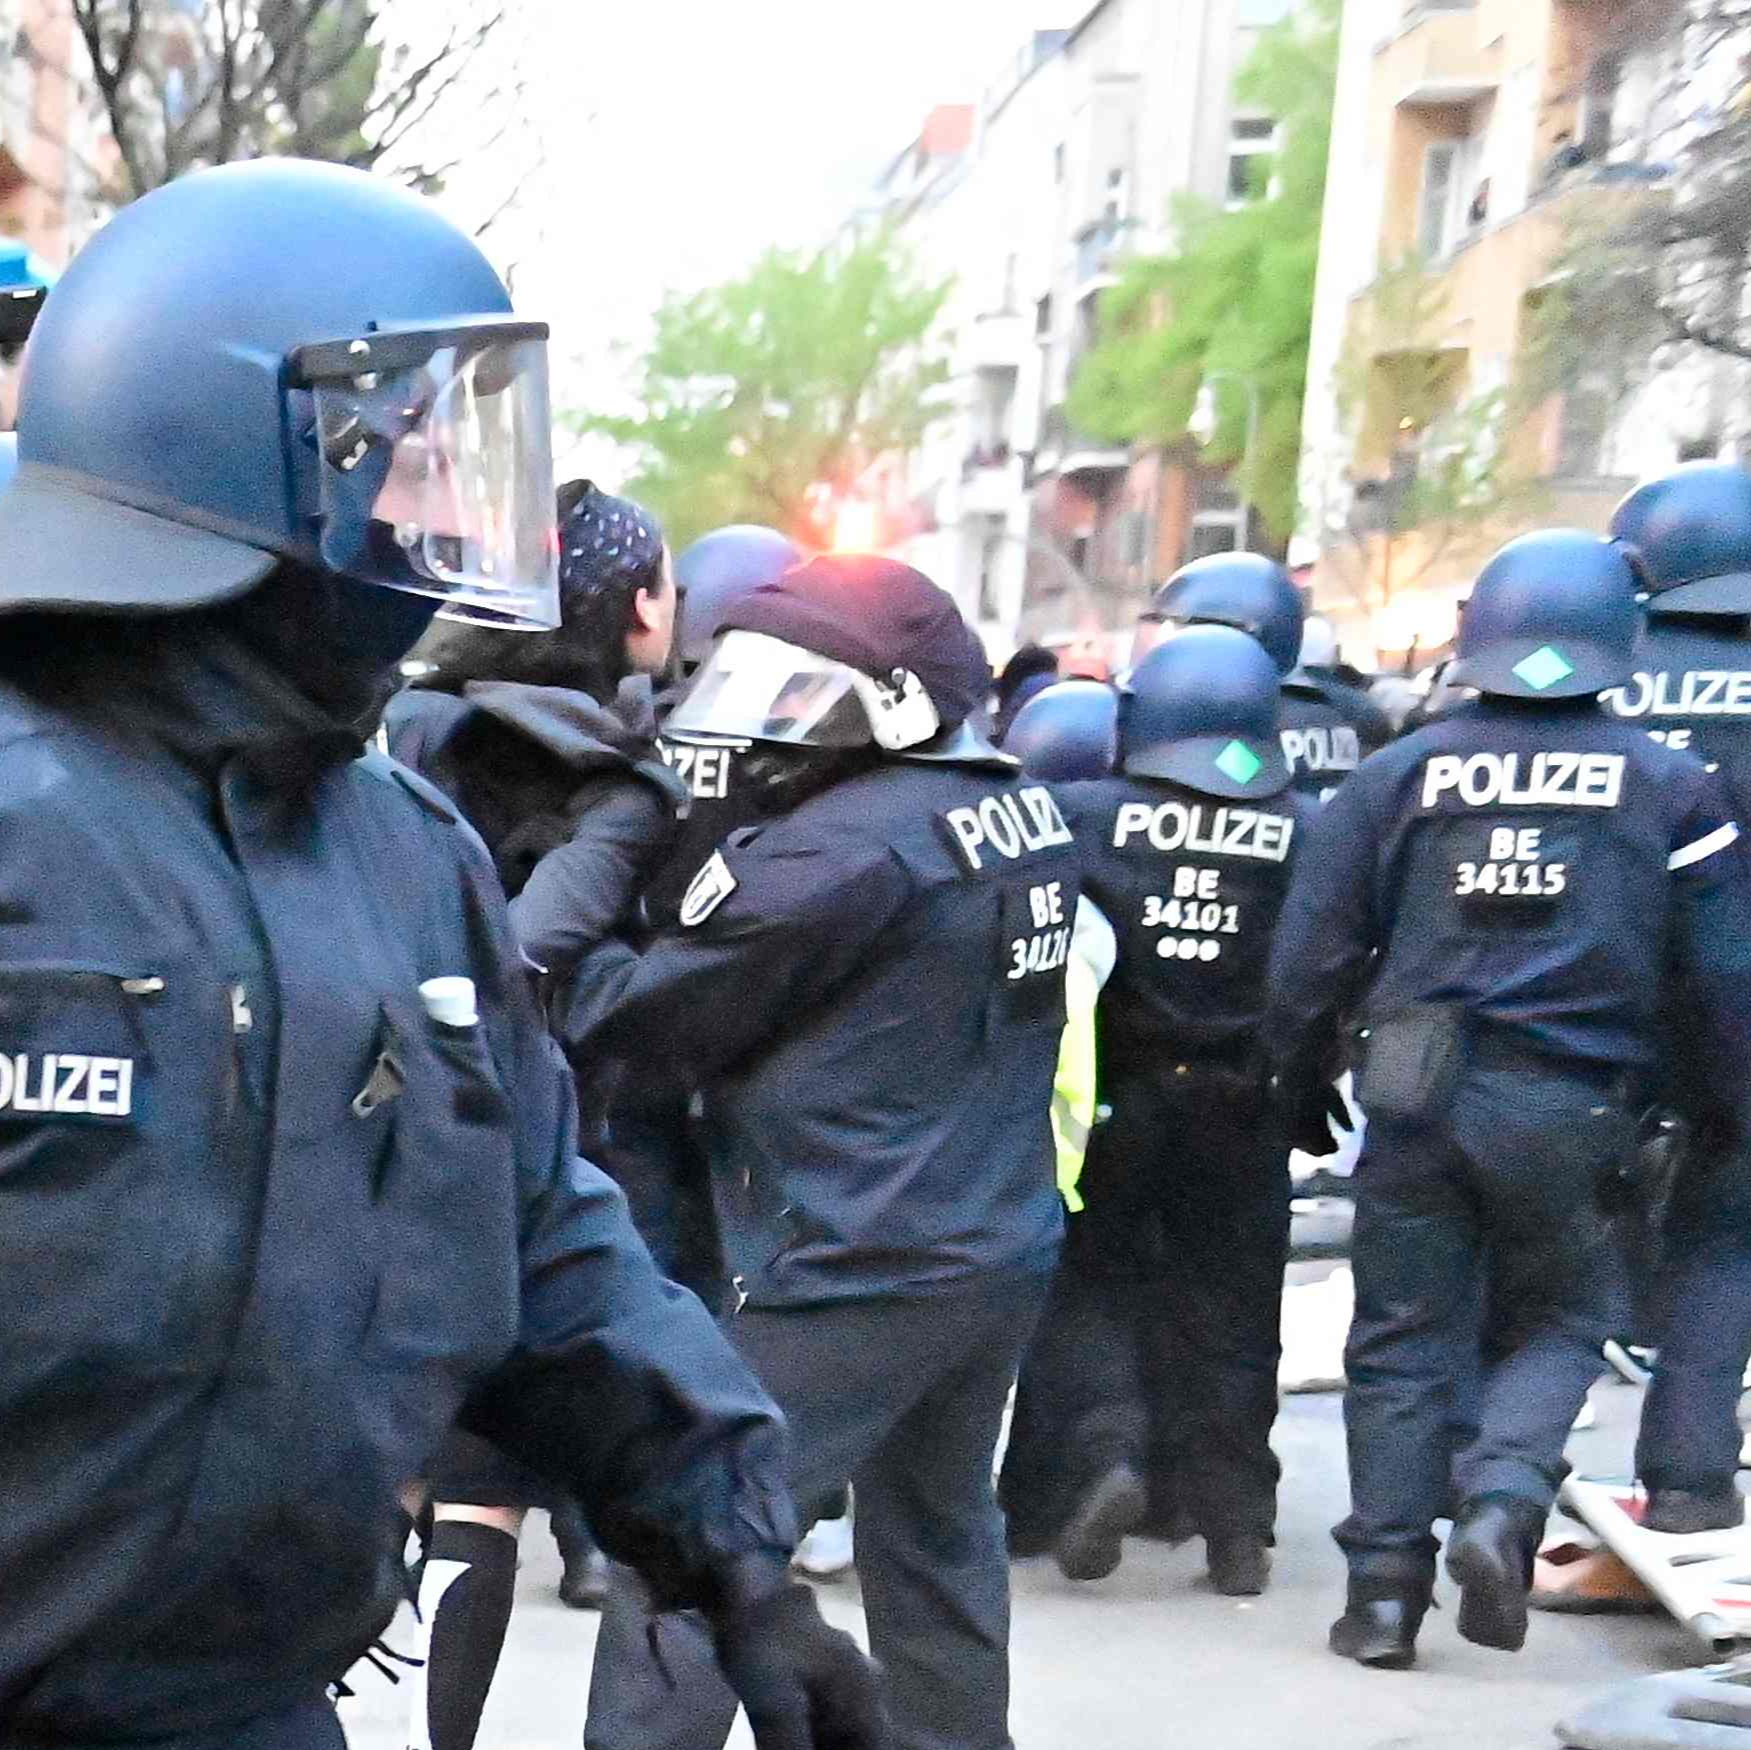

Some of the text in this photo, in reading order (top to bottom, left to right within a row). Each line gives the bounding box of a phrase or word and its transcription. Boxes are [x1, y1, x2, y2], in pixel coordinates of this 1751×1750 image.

[1421, 752, 1625, 808] POLIZEI
[1112, 801, 1295, 862] POLIZEI
[1489, 827, 1542, 861] BE
[1173, 866, 1220, 900] BE
[1454, 862, 1565, 896] 34115
[1029, 881, 1064, 928] BE
[1141, 896, 1239, 934] 34101
